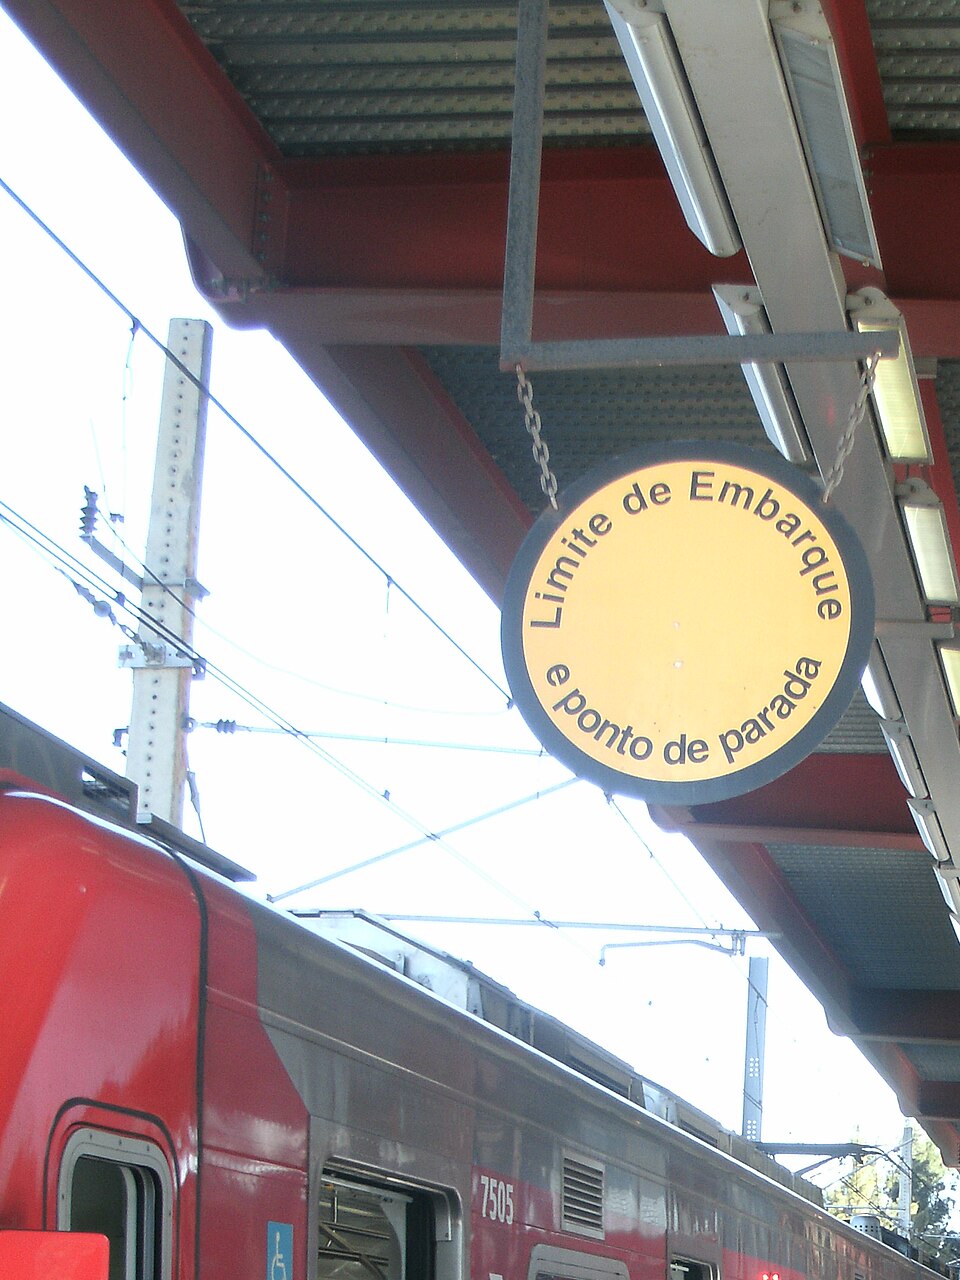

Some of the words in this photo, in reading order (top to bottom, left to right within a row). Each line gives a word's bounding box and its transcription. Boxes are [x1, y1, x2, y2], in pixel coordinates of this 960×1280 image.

[531, 513, 612, 629] Limite
[622, 482, 672, 516] de
[690, 471, 842, 621] Embarque
[546, 663, 570, 687] e
[552, 688, 653, 761] ponto
[718, 656, 822, 763] parada
[663, 733, 709, 765] de
[480, 1175, 514, 1225] 7505
